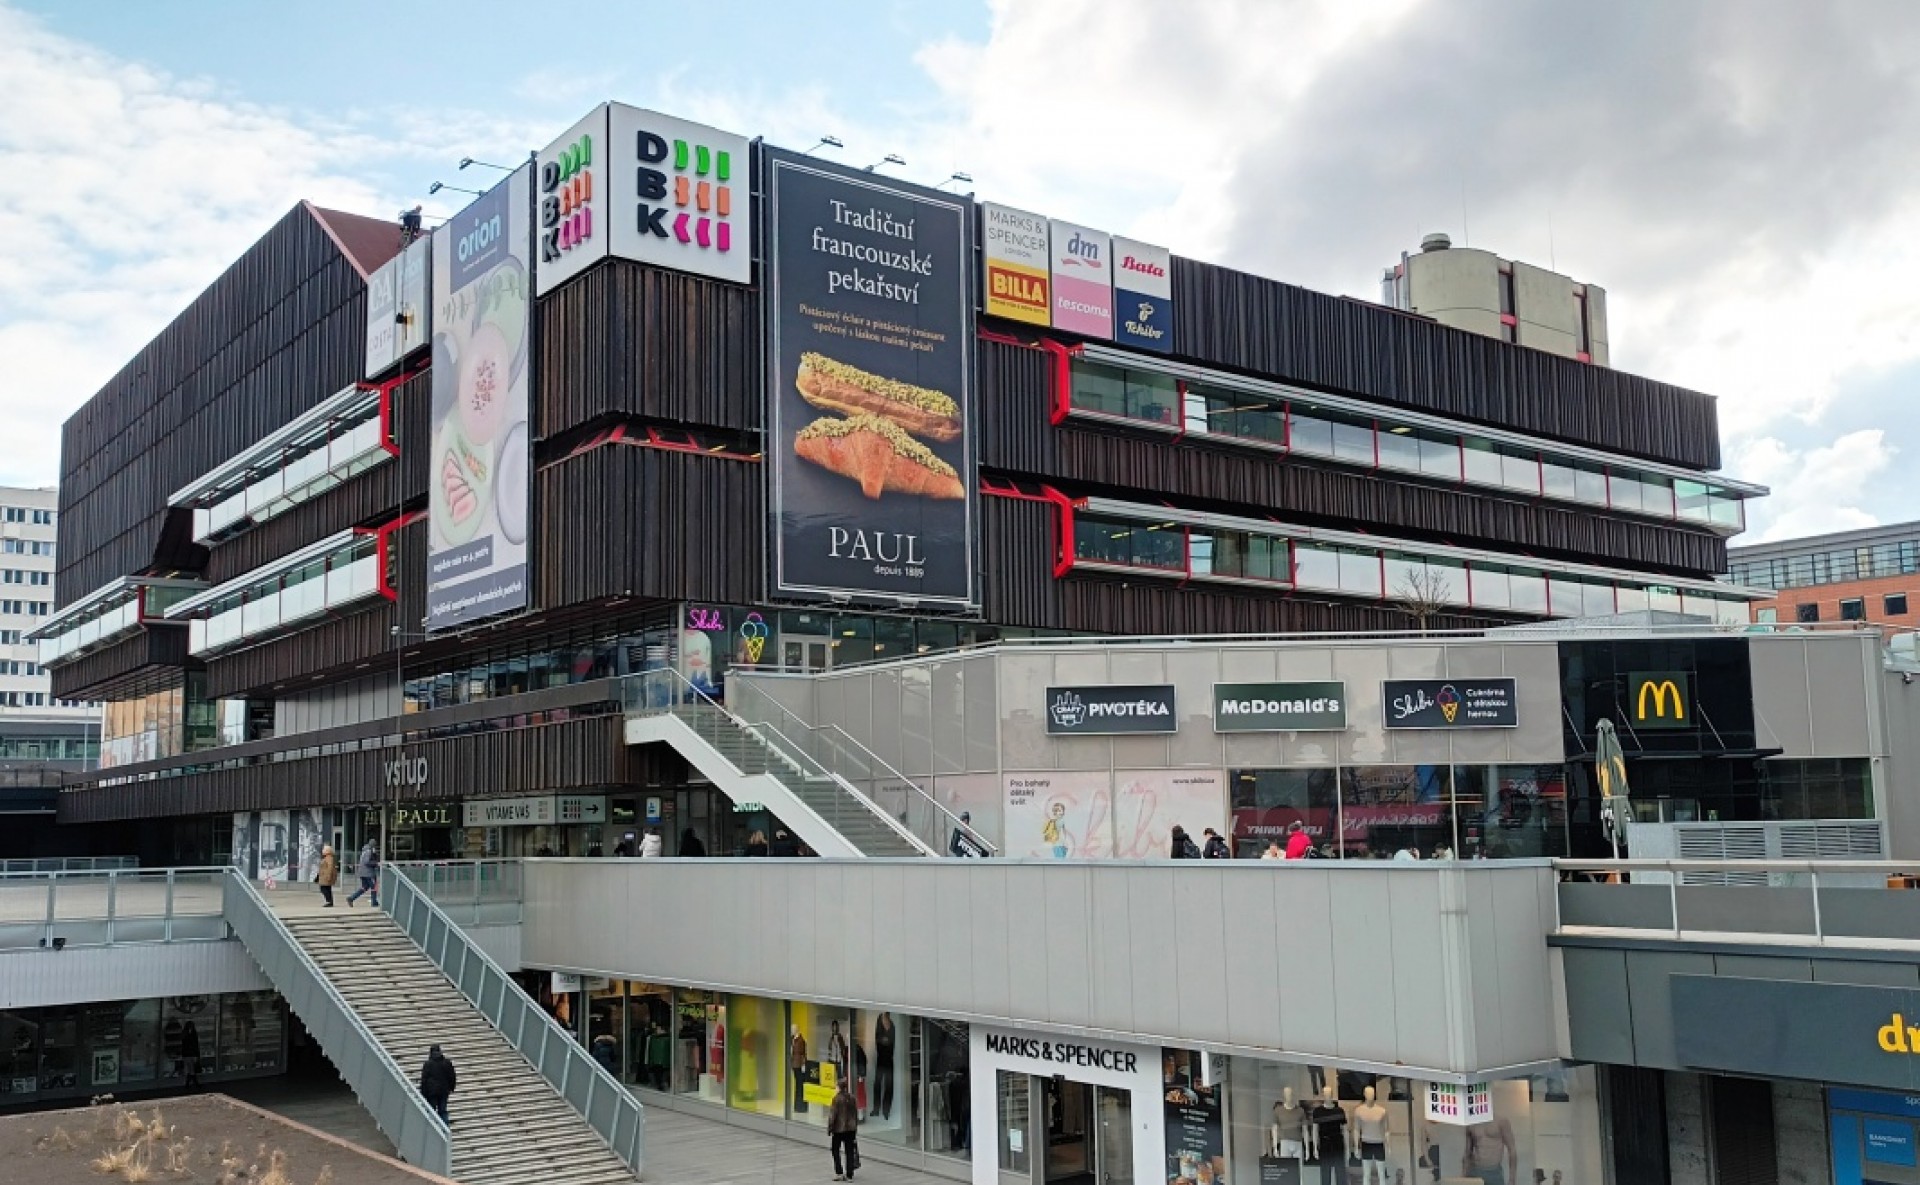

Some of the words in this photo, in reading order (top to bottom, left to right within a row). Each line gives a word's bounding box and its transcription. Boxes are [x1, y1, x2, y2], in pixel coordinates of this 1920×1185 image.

[829, 199, 915, 241] Tradiční
[990, 209, 1033, 233] MARKS
[1035, 222, 1043, 234] &
[458, 214, 502, 262] orion
[812, 227, 932, 276] francouzské
[988, 227, 1046, 252] SPENCER
[1067, 232, 1098, 260] dm
[828, 267, 919, 304] pekařství
[993, 272, 1044, 303] BILLA
[828, 526, 927, 565] PAUL
[1089, 700, 1169, 717] PIVOTÉKA
[1220, 698, 1340, 714] McDonald's
[385, 752, 428, 792] vstup
[398, 809, 452, 824] PAUL
[987, 1033, 1039, 1059] MARKS
[1042, 1042, 1053, 1061] &
[1055, 1043, 1137, 1073] SPENCER
